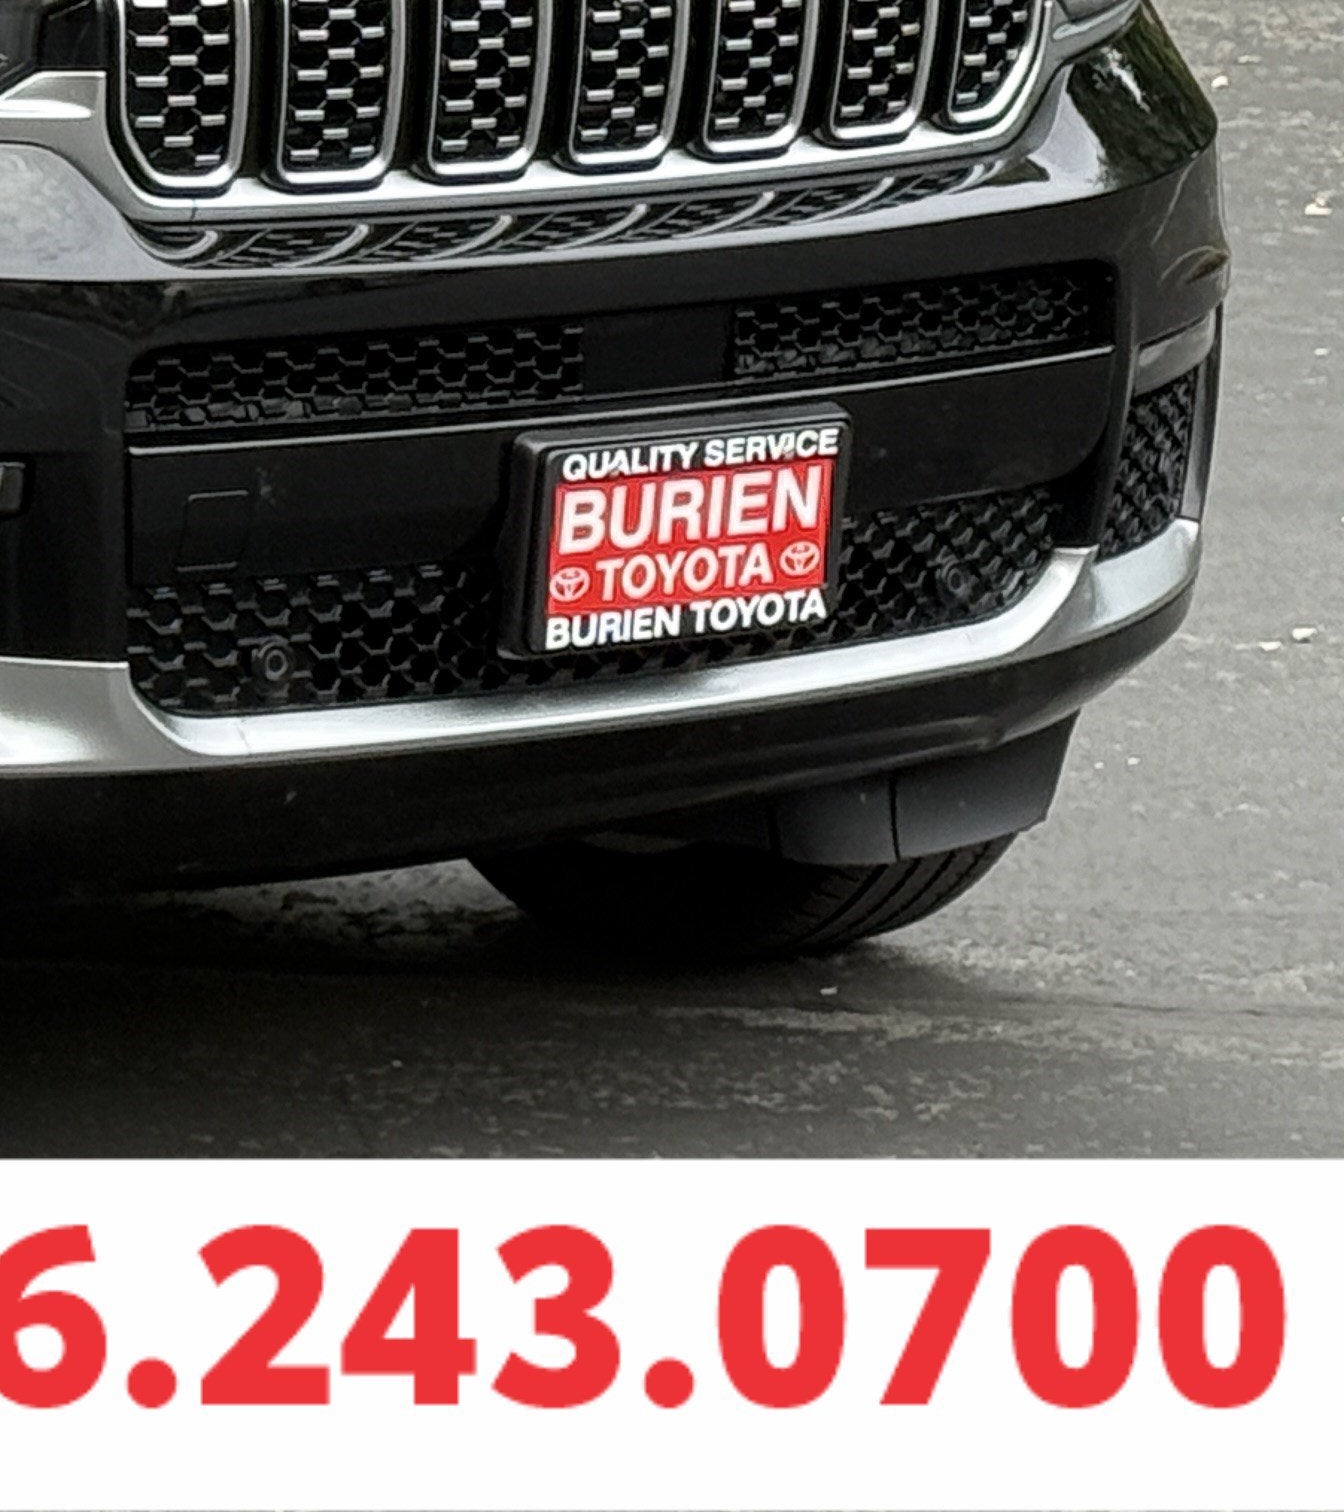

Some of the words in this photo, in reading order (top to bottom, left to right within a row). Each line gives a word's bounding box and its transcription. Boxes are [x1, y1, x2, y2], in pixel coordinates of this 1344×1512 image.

[562, 441, 699, 481] QUALITY
[703, 428, 841, 468] SERVICE
[558, 464, 822, 556] BURIEN
[595, 542, 775, 602] TOYOTA
[545, 604, 681, 651] BURIEN
[685, 589, 827, 635] TOYOTA
